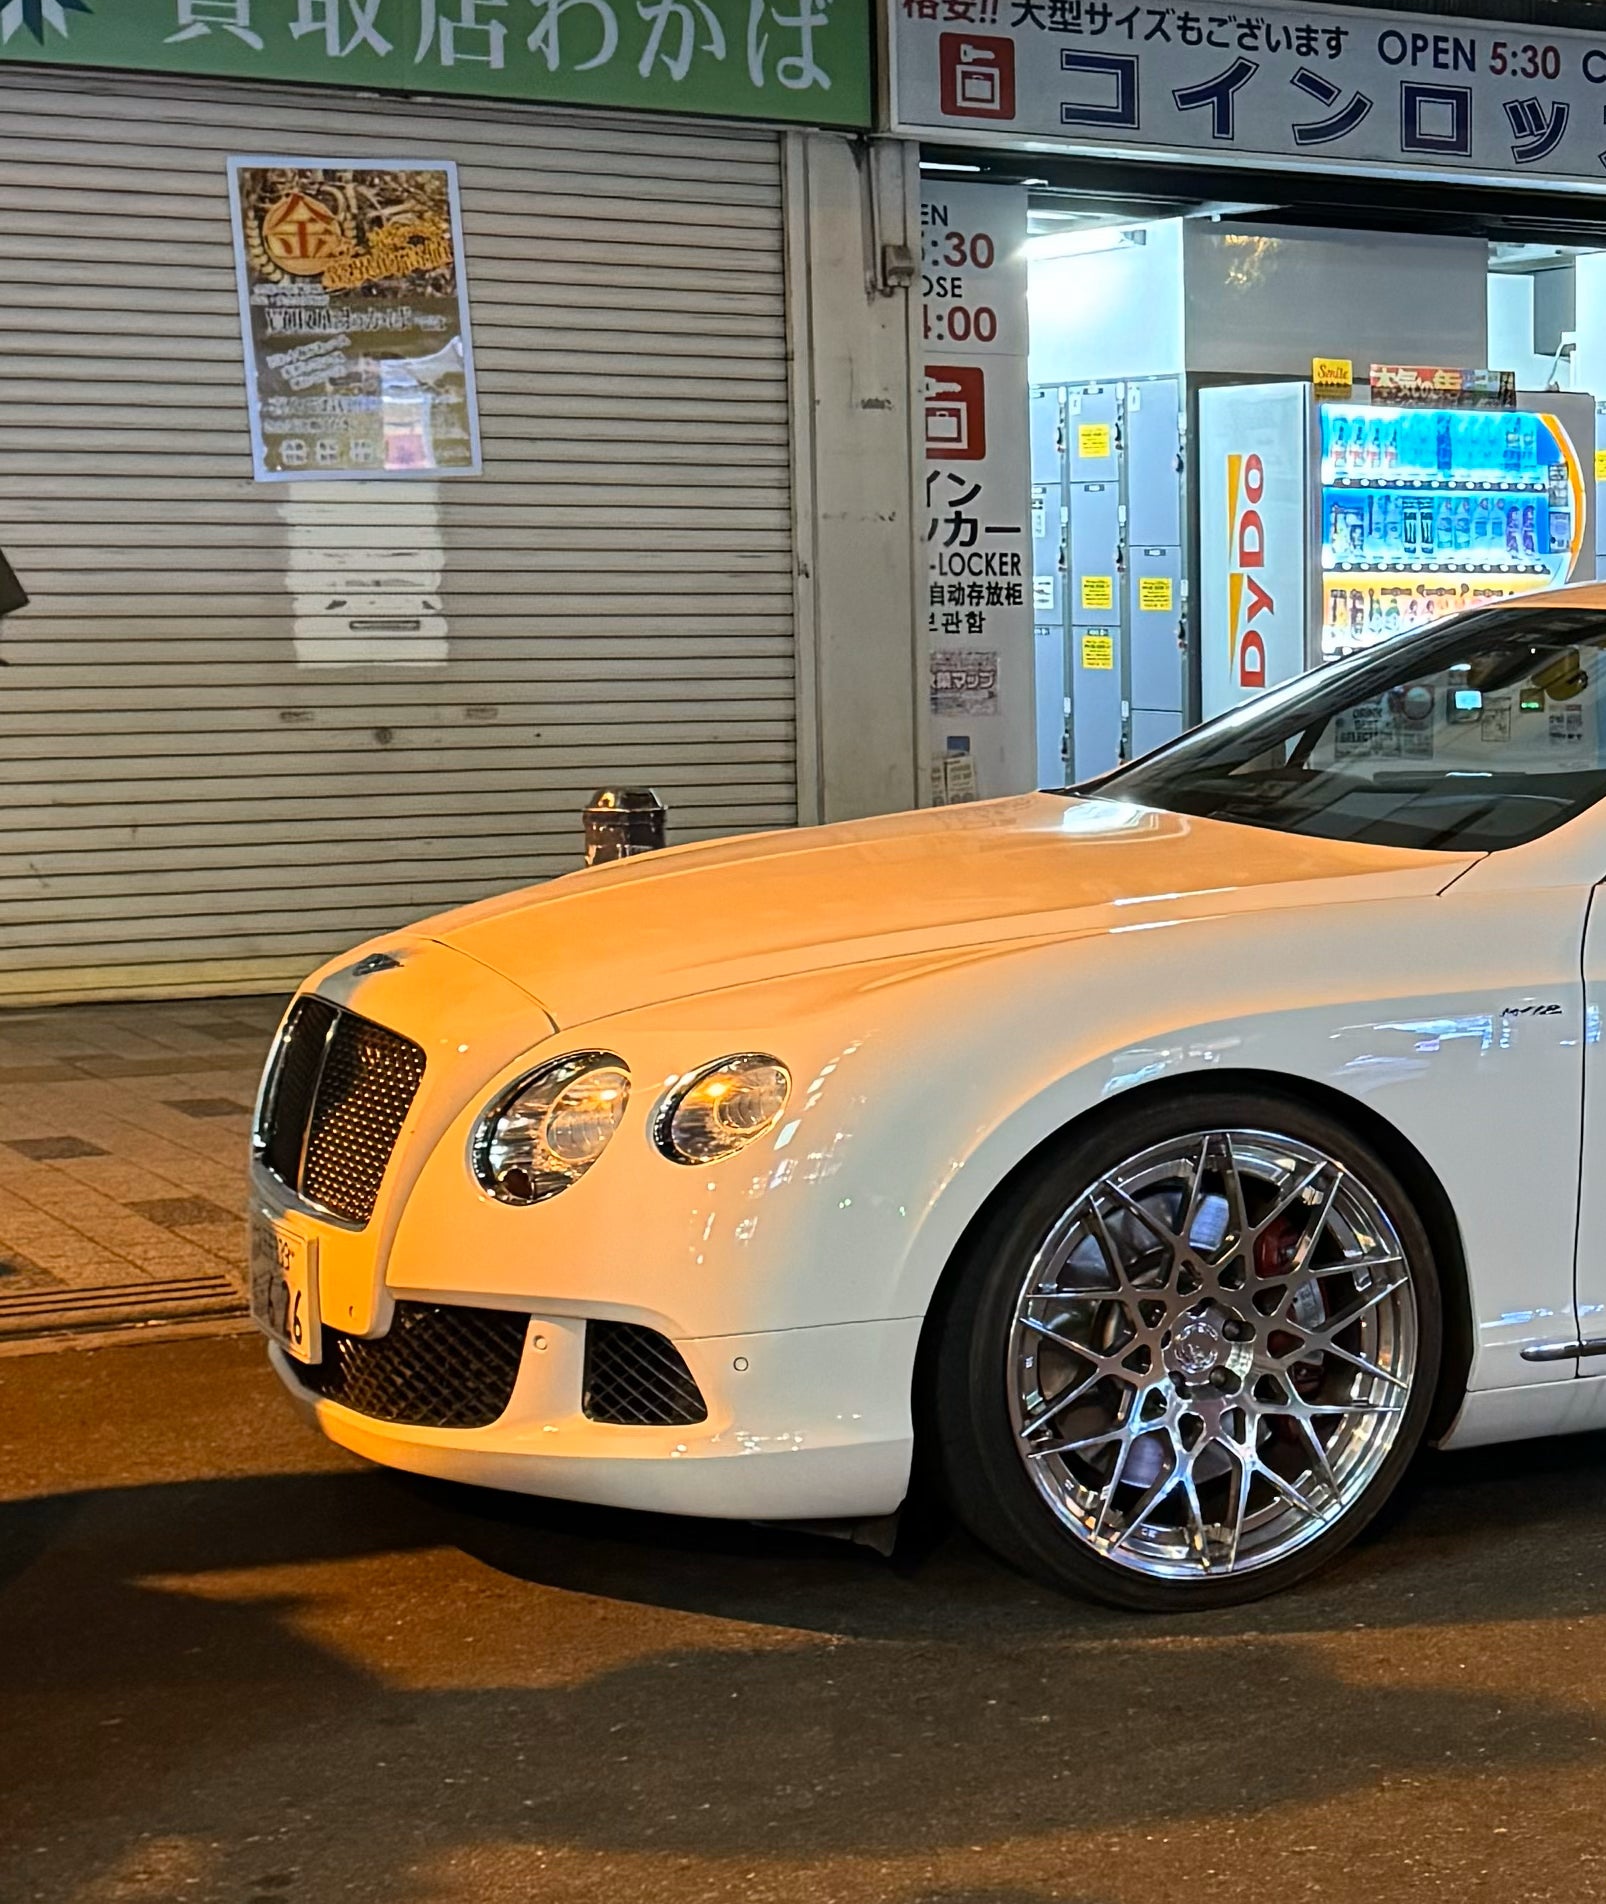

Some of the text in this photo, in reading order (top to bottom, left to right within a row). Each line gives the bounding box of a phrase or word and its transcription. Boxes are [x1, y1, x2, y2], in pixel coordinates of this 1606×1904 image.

[1377, 28, 1477, 73] OPEN
[1488, 41, 1563, 81] 5:30
[921, 231, 995, 269] :30
[923, 304, 998, 343] :00
[927, 510, 1021, 548] カー
[929, 581, 1024, 607] 自动存放柜
